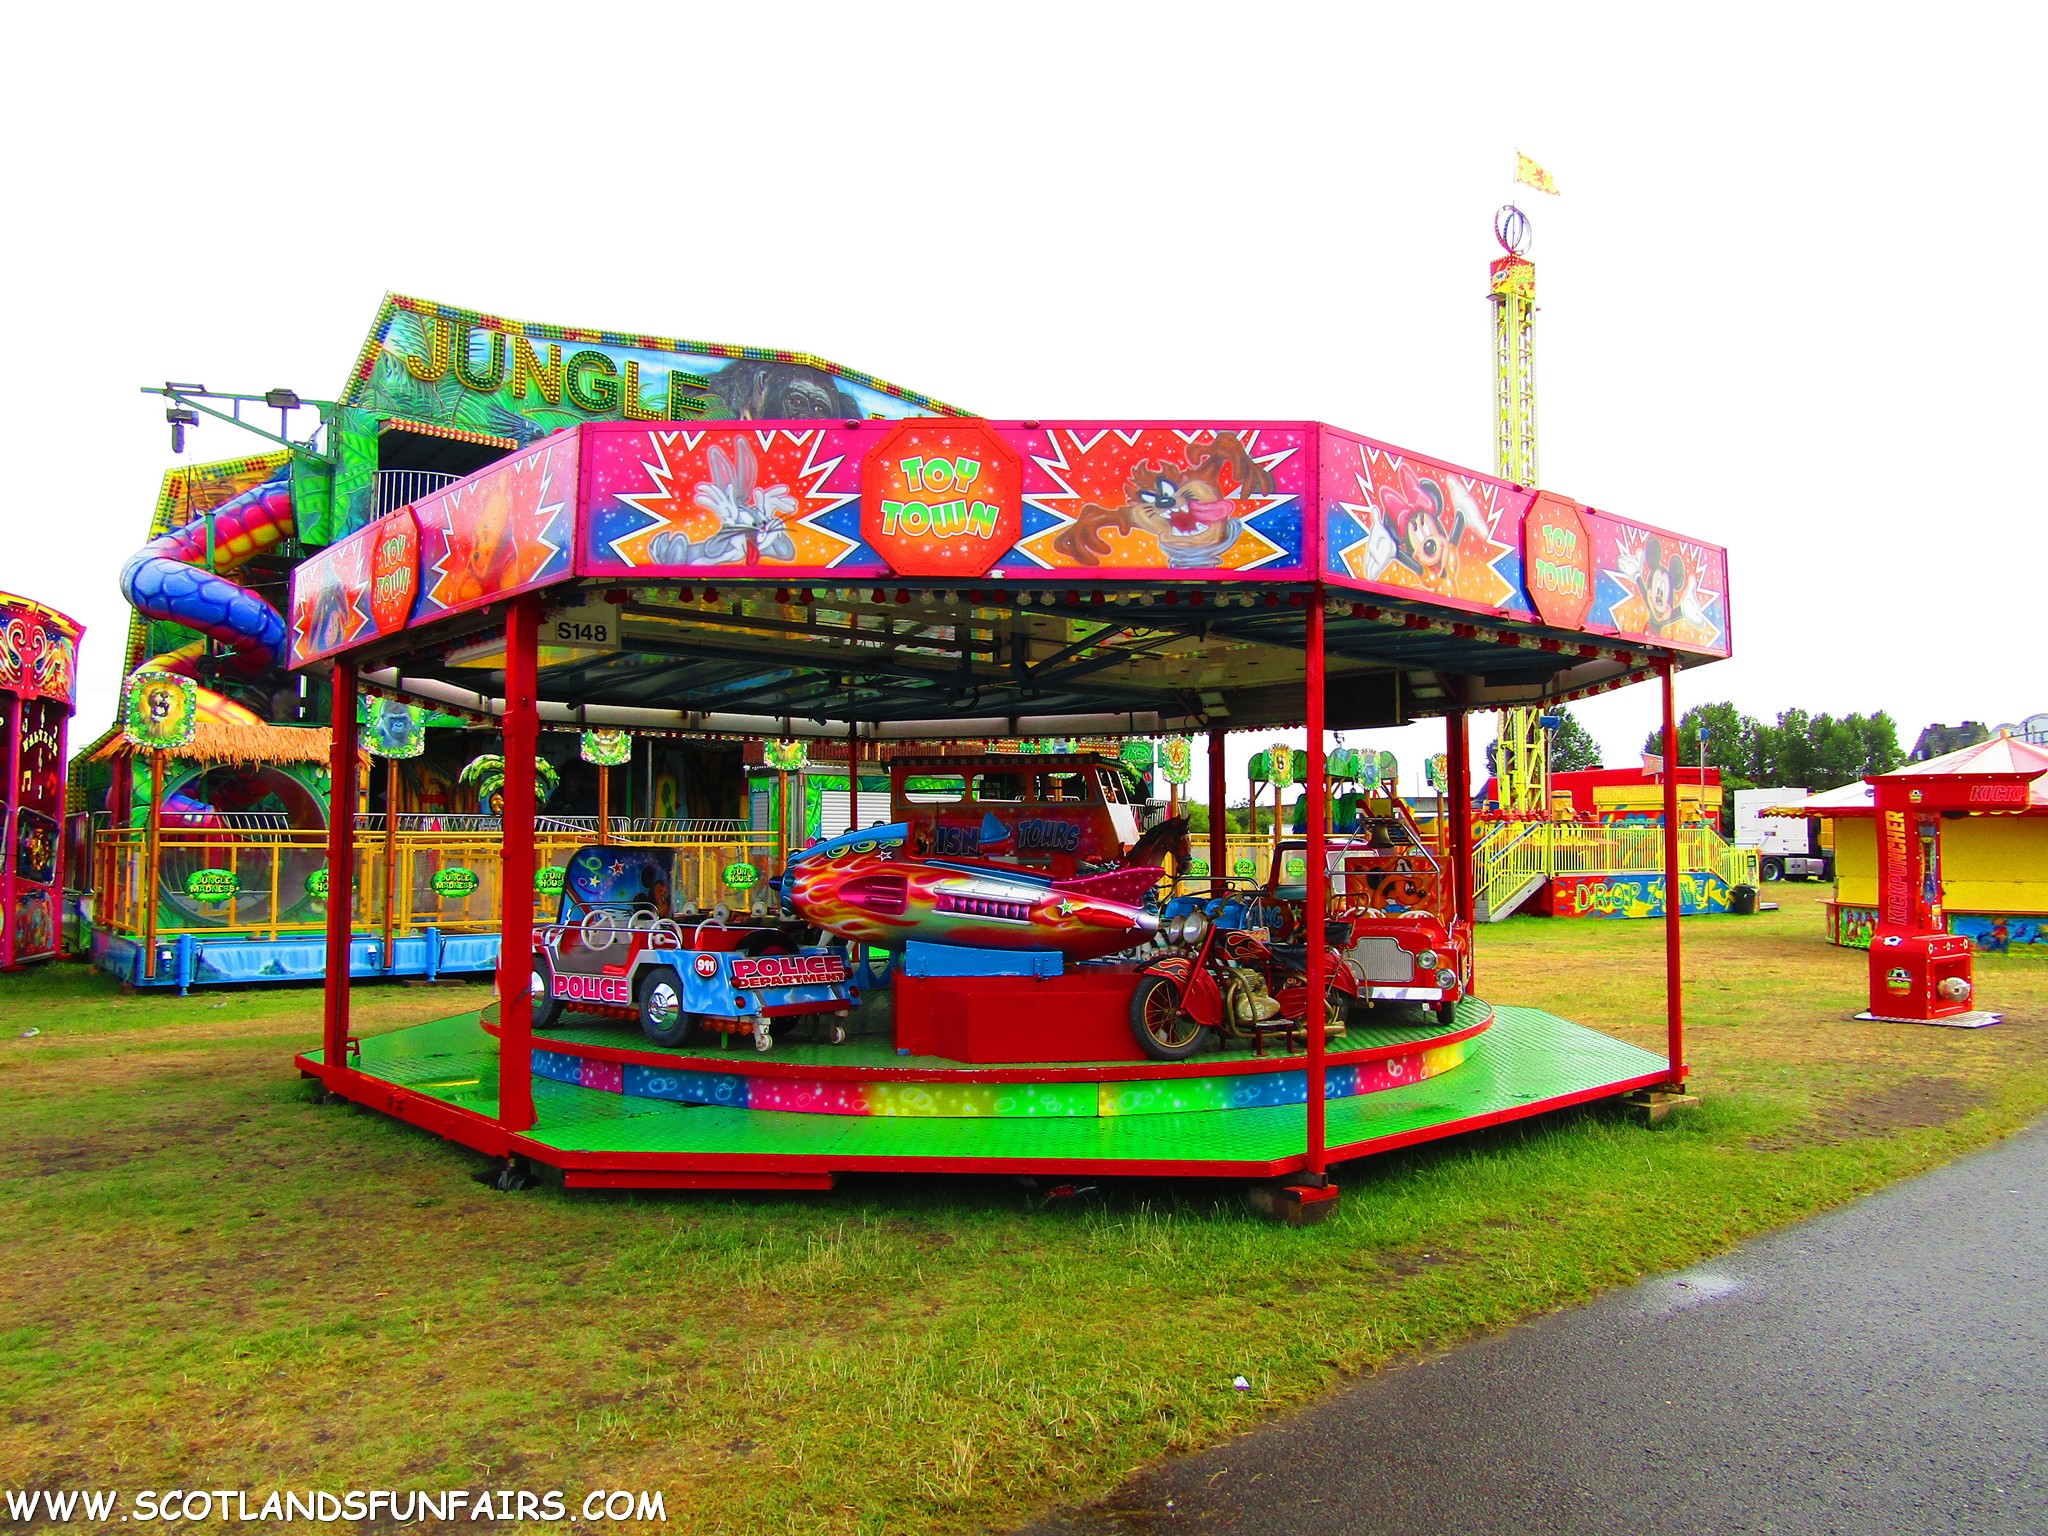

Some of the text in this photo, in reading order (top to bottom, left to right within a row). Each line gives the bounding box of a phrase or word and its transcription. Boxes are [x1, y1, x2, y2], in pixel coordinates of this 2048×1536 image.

[405, 319, 711, 422] JUNGLE
[900, 455, 981, 494] TOY
[881, 499, 999, 539] TOWN
[383, 534, 406, 568] TOY
[1542, 524, 1576, 559] TOY
[376, 567, 411, 602] TOWN
[1535, 557, 1585, 599] TOWN
[557, 621, 608, 642] S148
[1018, 818, 1081, 851] TOURS
[197, 876, 231, 884] JUNGLE
[540, 879, 564, 887] HOUS
[1885, 810, 1909, 925] KICKPUNCHER
[190, 884, 235, 893] MADNESS
[1574, 881, 1642, 911] DROP
[697, 958, 715, 972] 911
[732, 956, 844, 978] POLICE
[553, 975, 628, 1003] POLICE
[737, 974, 846, 989] DEPARTMENT
